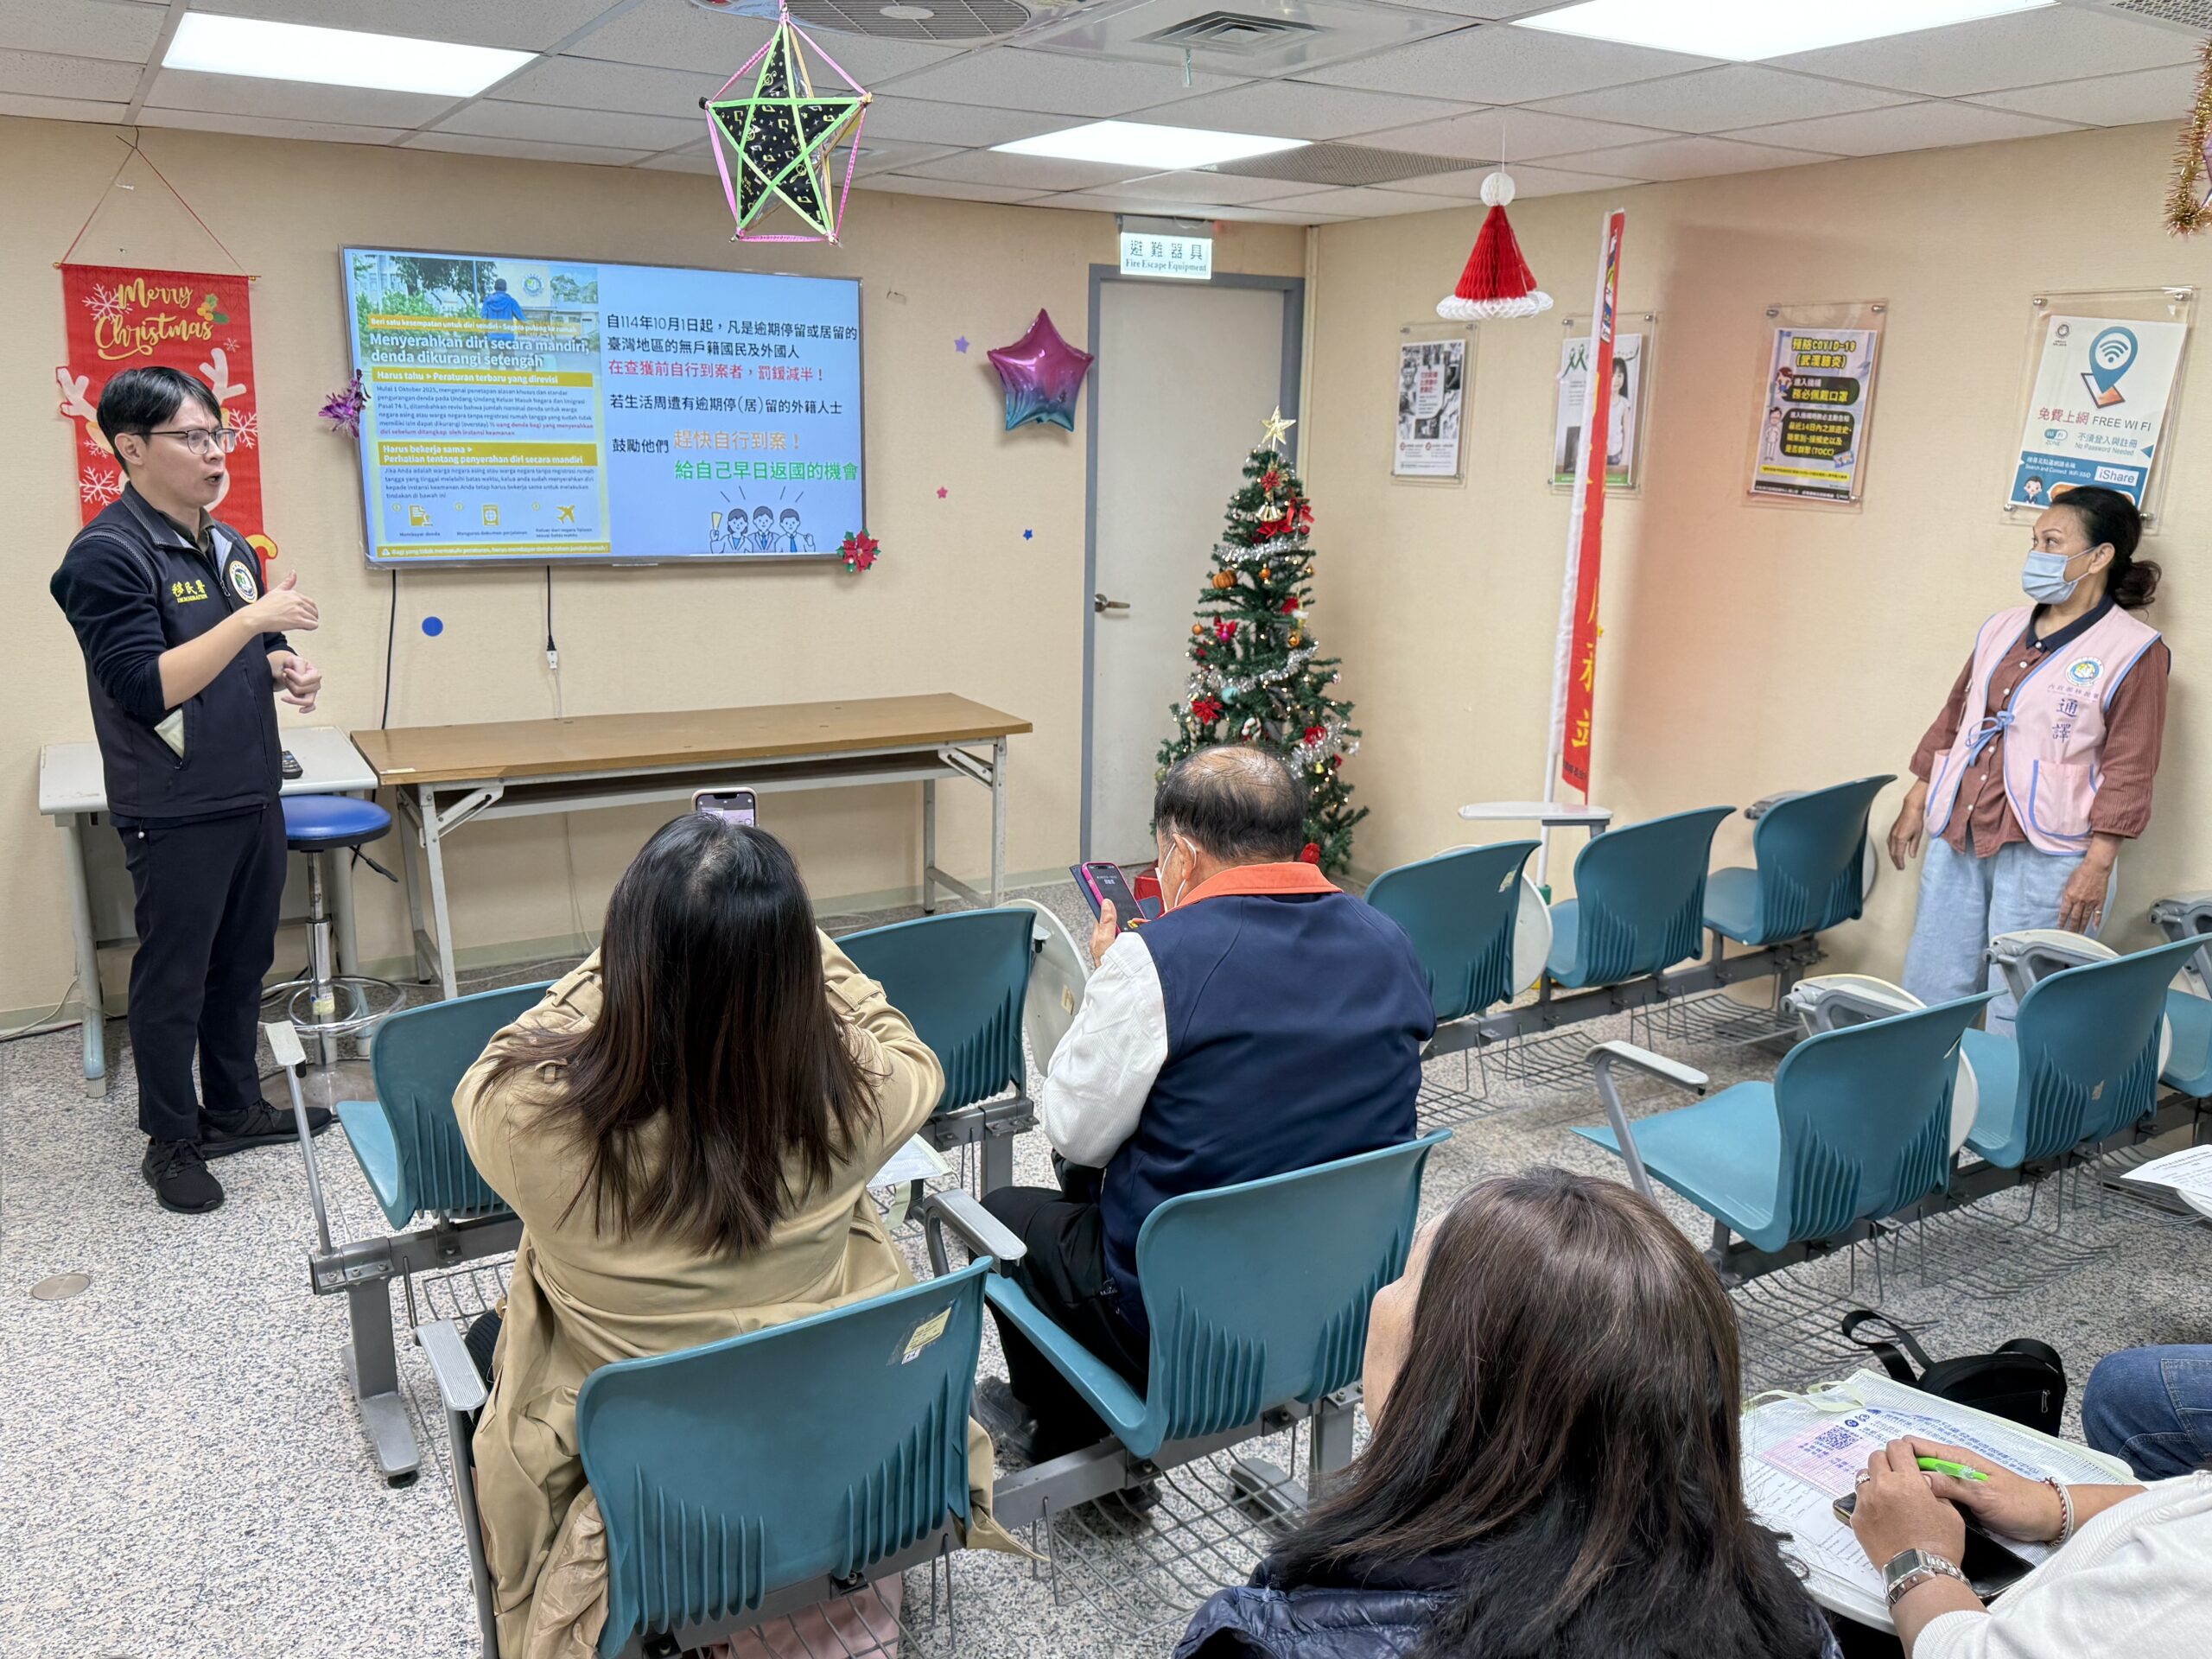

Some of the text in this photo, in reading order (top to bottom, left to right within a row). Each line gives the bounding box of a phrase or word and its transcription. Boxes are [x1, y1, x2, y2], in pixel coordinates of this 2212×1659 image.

[1130, 240, 1203, 260] 避難器具
[1126, 258, 1206, 273] Fire Escape Equipment
[116, 277, 193, 310] Merry
[94, 312, 213, 360] Christmas
[370, 333, 589, 354] Menyerahkan diri secara mandiri,
[607, 335, 799, 359] 臺灣地區的無戶籍國民及外國人
[372, 349, 543, 369] denda dikurangi setengah
[433, 372, 474, 381] Peraturan
[529, 375, 558, 384] direvisi
[2038, 407, 2090, 425] 免費上網
[2092, 416, 2121, 428] FREE
[410, 444, 442, 454] bekerja
[612, 438, 669, 454] 鼓勵他們
[2083, 443, 2111, 454] Password
[2112, 446, 2134, 455] Needed
[384, 454, 424, 463] Perhatian
[427, 455, 459, 464] tentang
[461, 454, 508, 464] penyerahan
[675, 461, 859, 481] 給自己早日返國的機會
[2099, 469, 2135, 483] iShare
